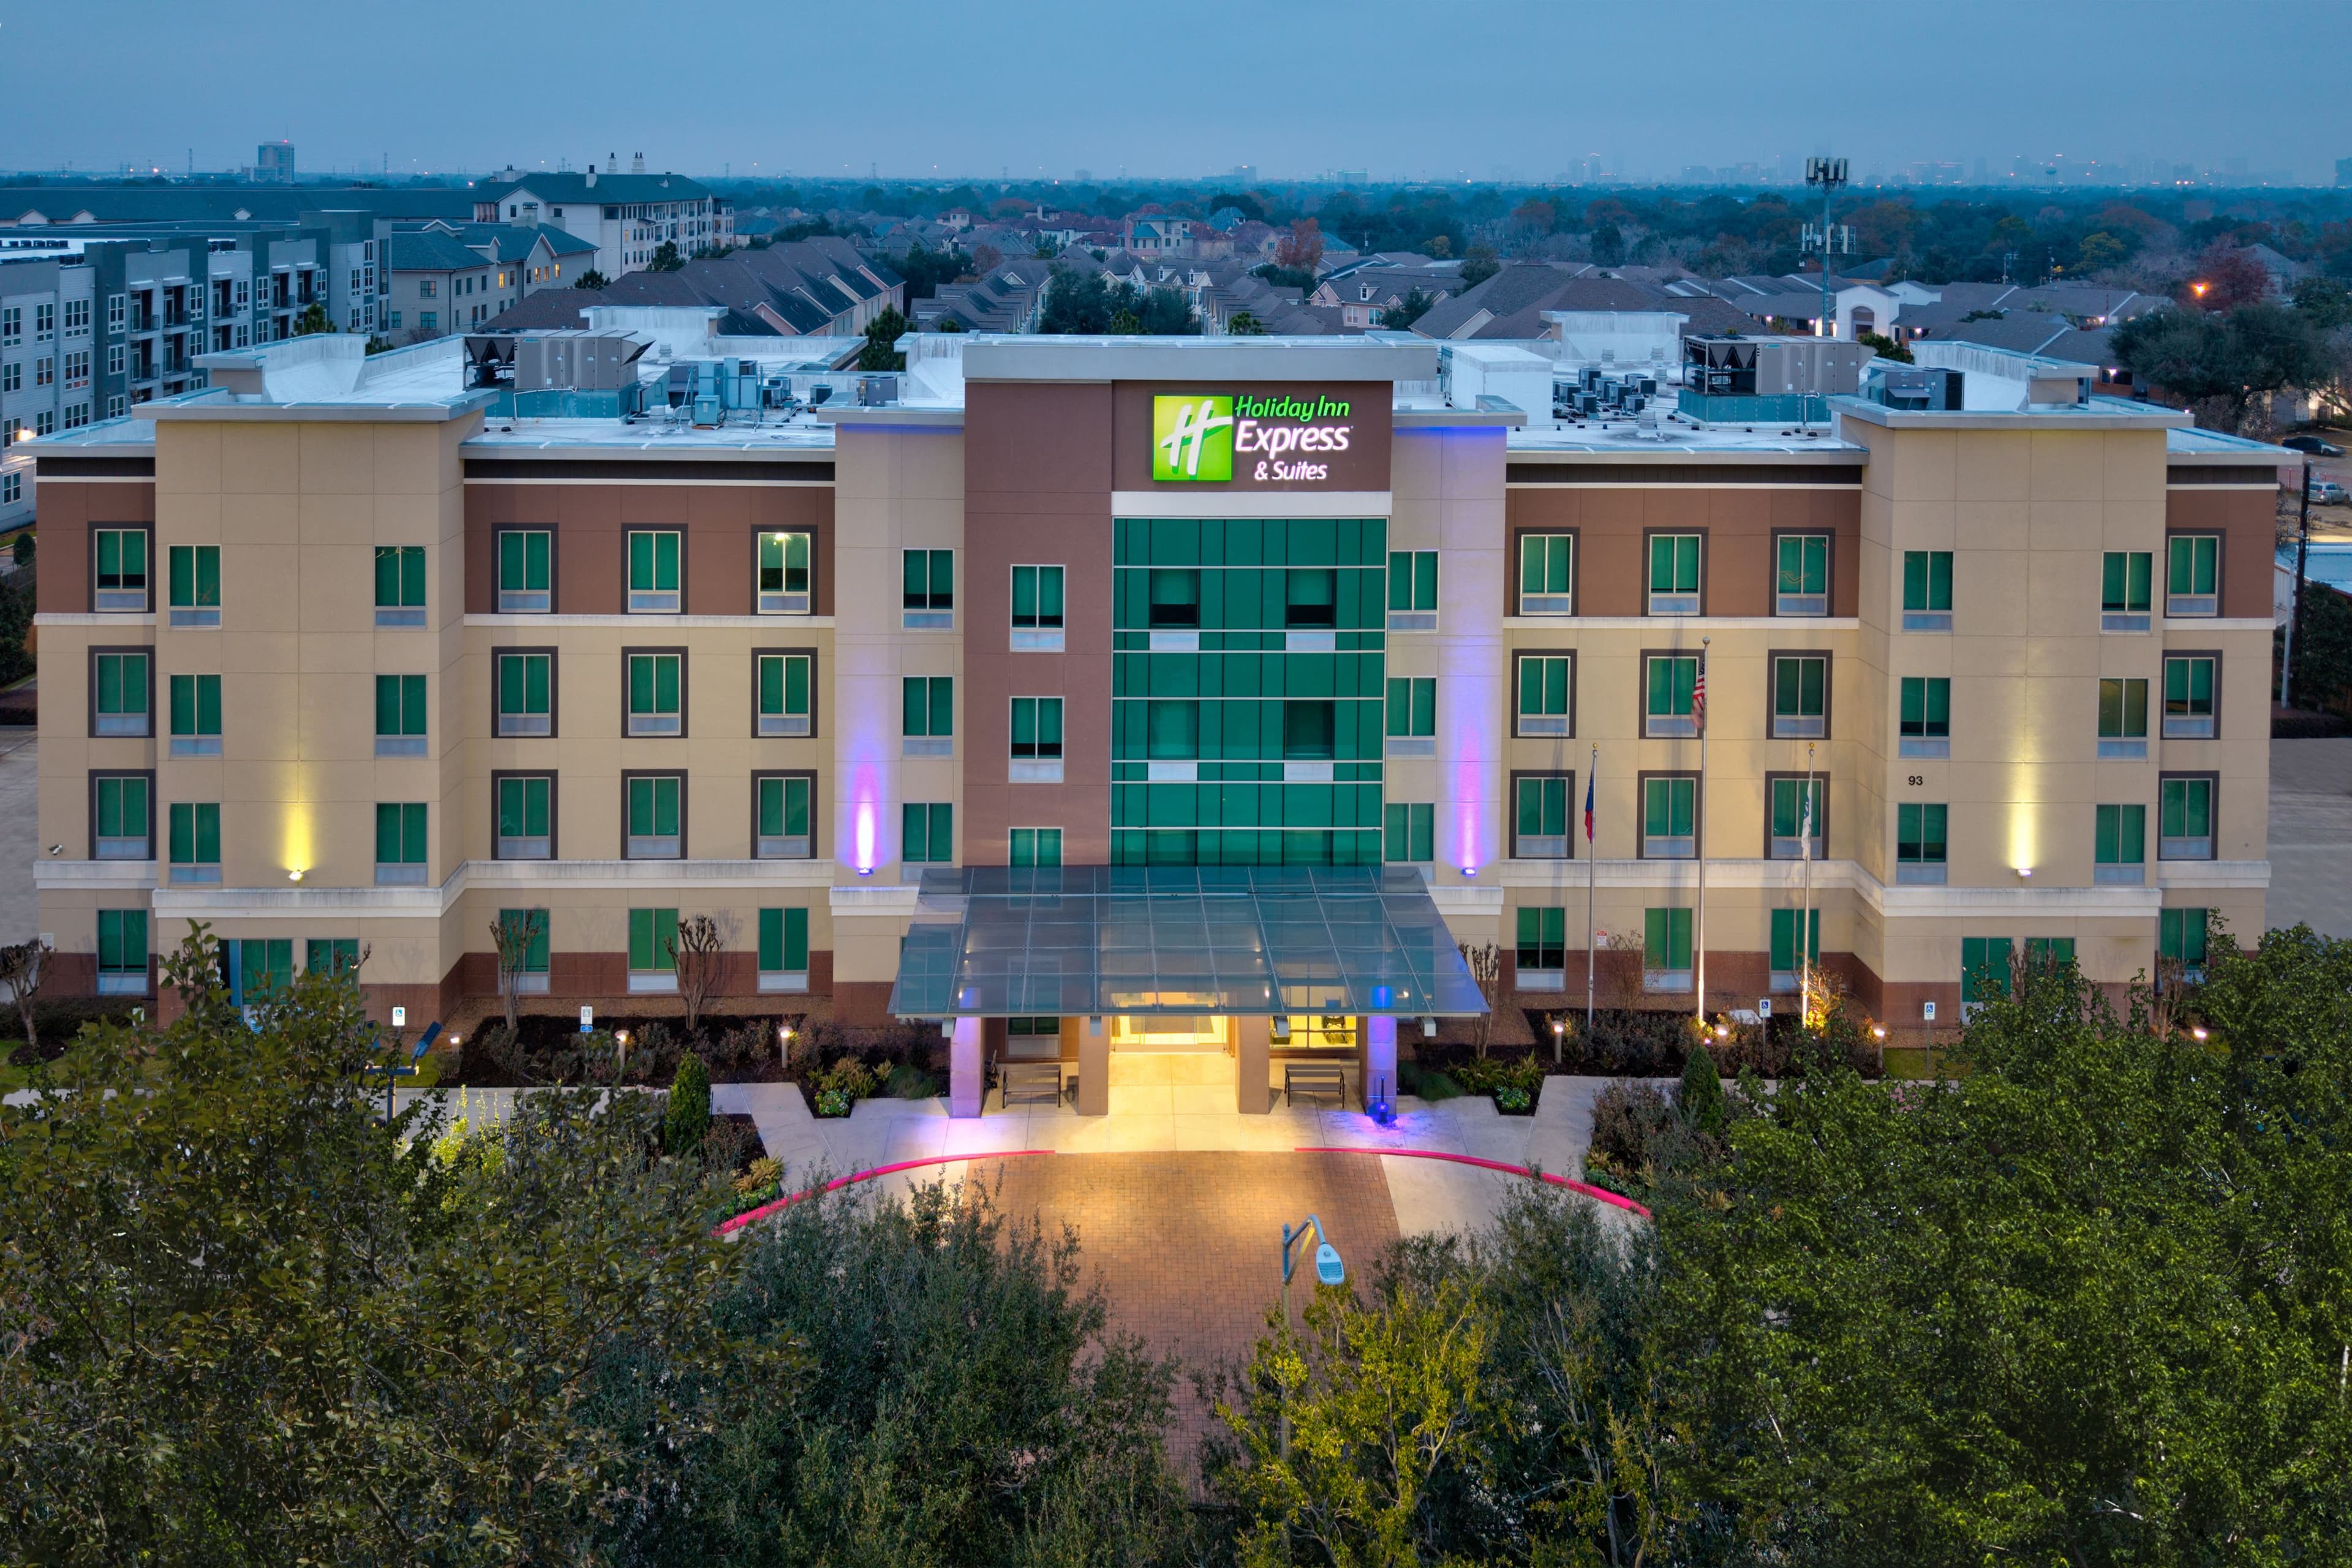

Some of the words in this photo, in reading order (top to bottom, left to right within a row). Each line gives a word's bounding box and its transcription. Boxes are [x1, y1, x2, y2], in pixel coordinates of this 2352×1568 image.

[1235, 395, 1314, 422] Holiday
[1317, 395, 1350, 417] Inn
[1235, 420, 1349, 459] Express
[1254, 461, 1270, 481] &
[1272, 461, 1328, 480] Suites
[1908, 775, 1923, 786] 93
